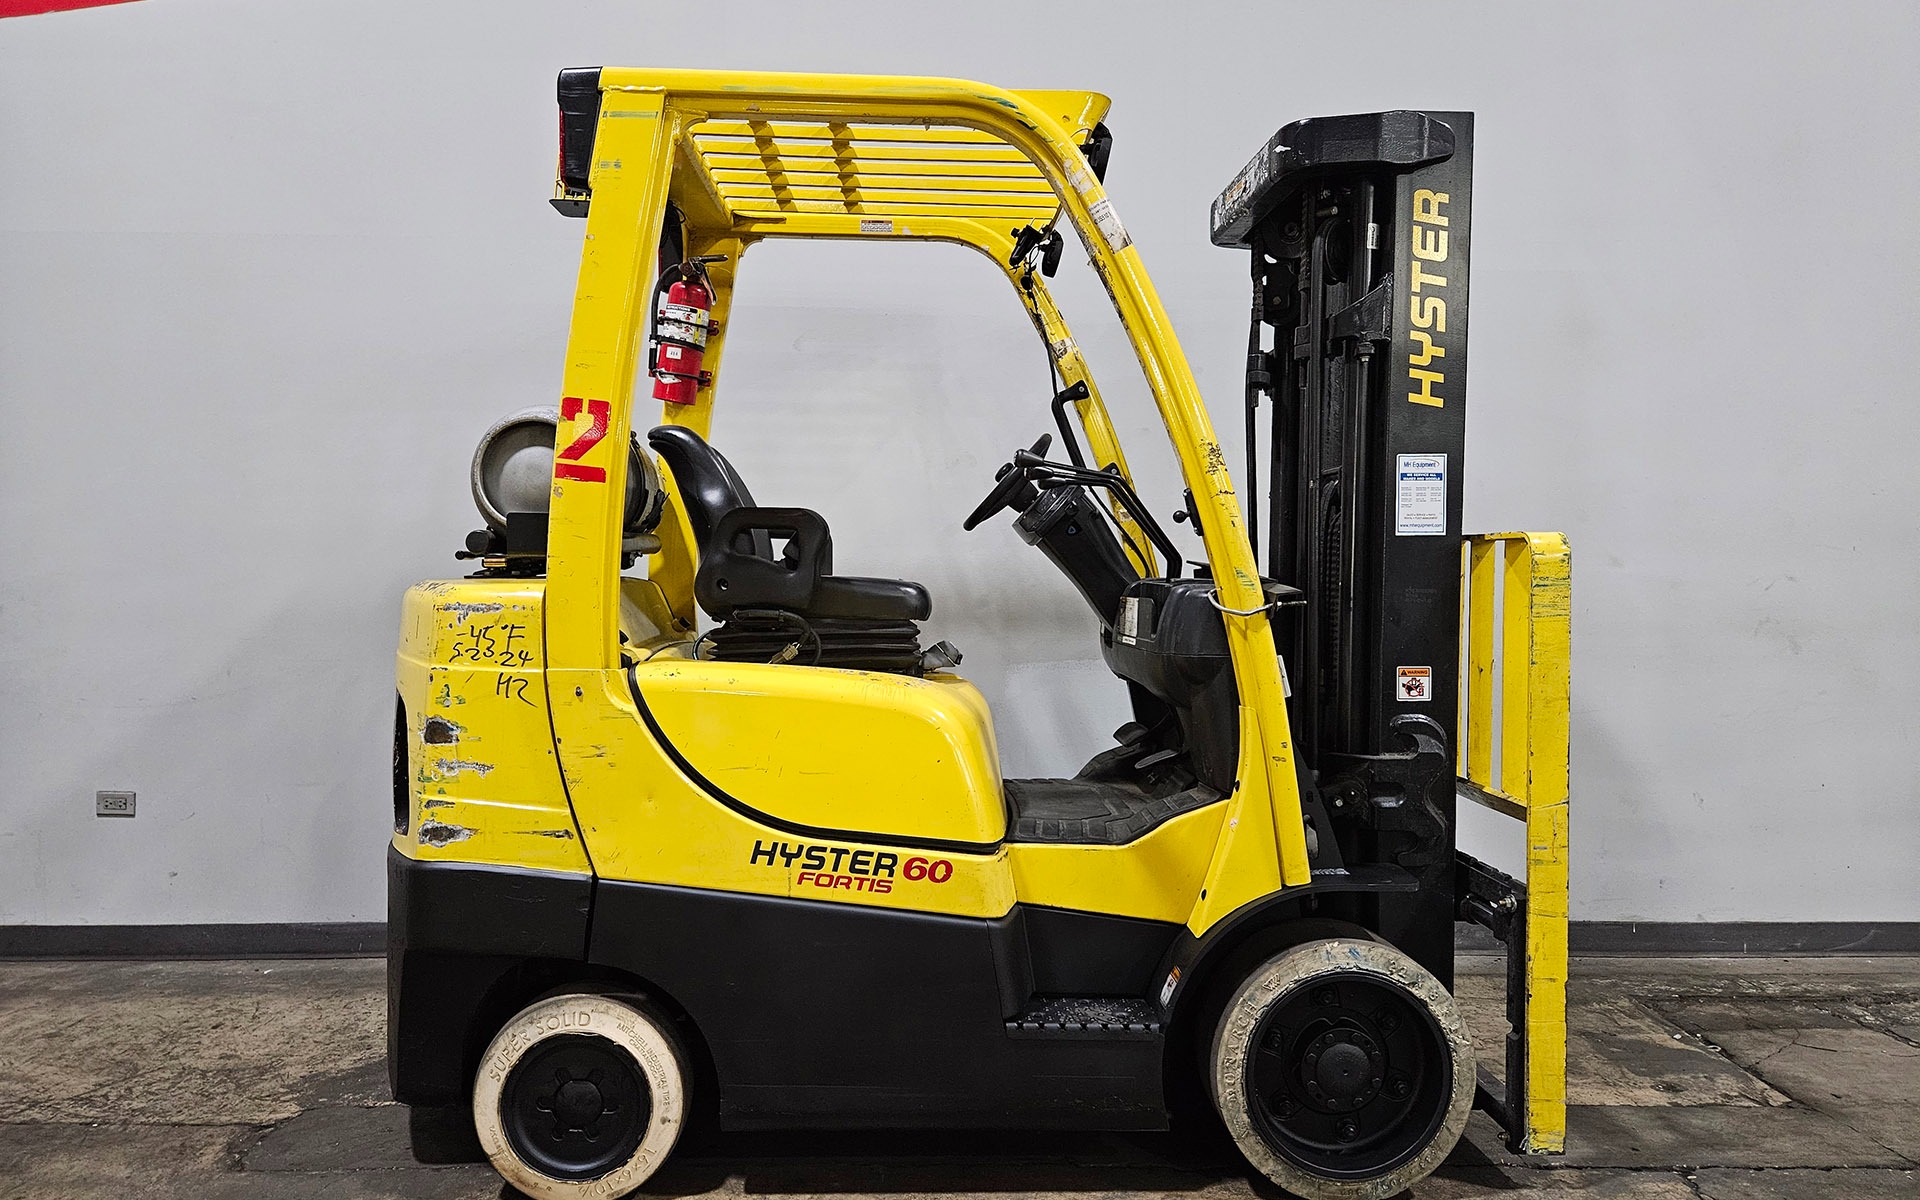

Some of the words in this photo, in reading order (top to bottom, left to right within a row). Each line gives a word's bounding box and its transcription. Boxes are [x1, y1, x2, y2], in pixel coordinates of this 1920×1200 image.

[1408, 188, 1450, 408] HYSTER
[555, 397, 611, 483] 12
[750, 840, 898, 877] HYSTER
[903, 857, 954, 884] 60
[797, 871, 893, 894] FORTIS
[489, 1030, 532, 1083] SUPER
[536, 1010, 592, 1036] SOLID
[615, 1022, 649, 1049] MITCHELL
[646, 1046, 670, 1088] INDUSTRIAL
[1222, 1001, 1258, 1101] MONARCH
